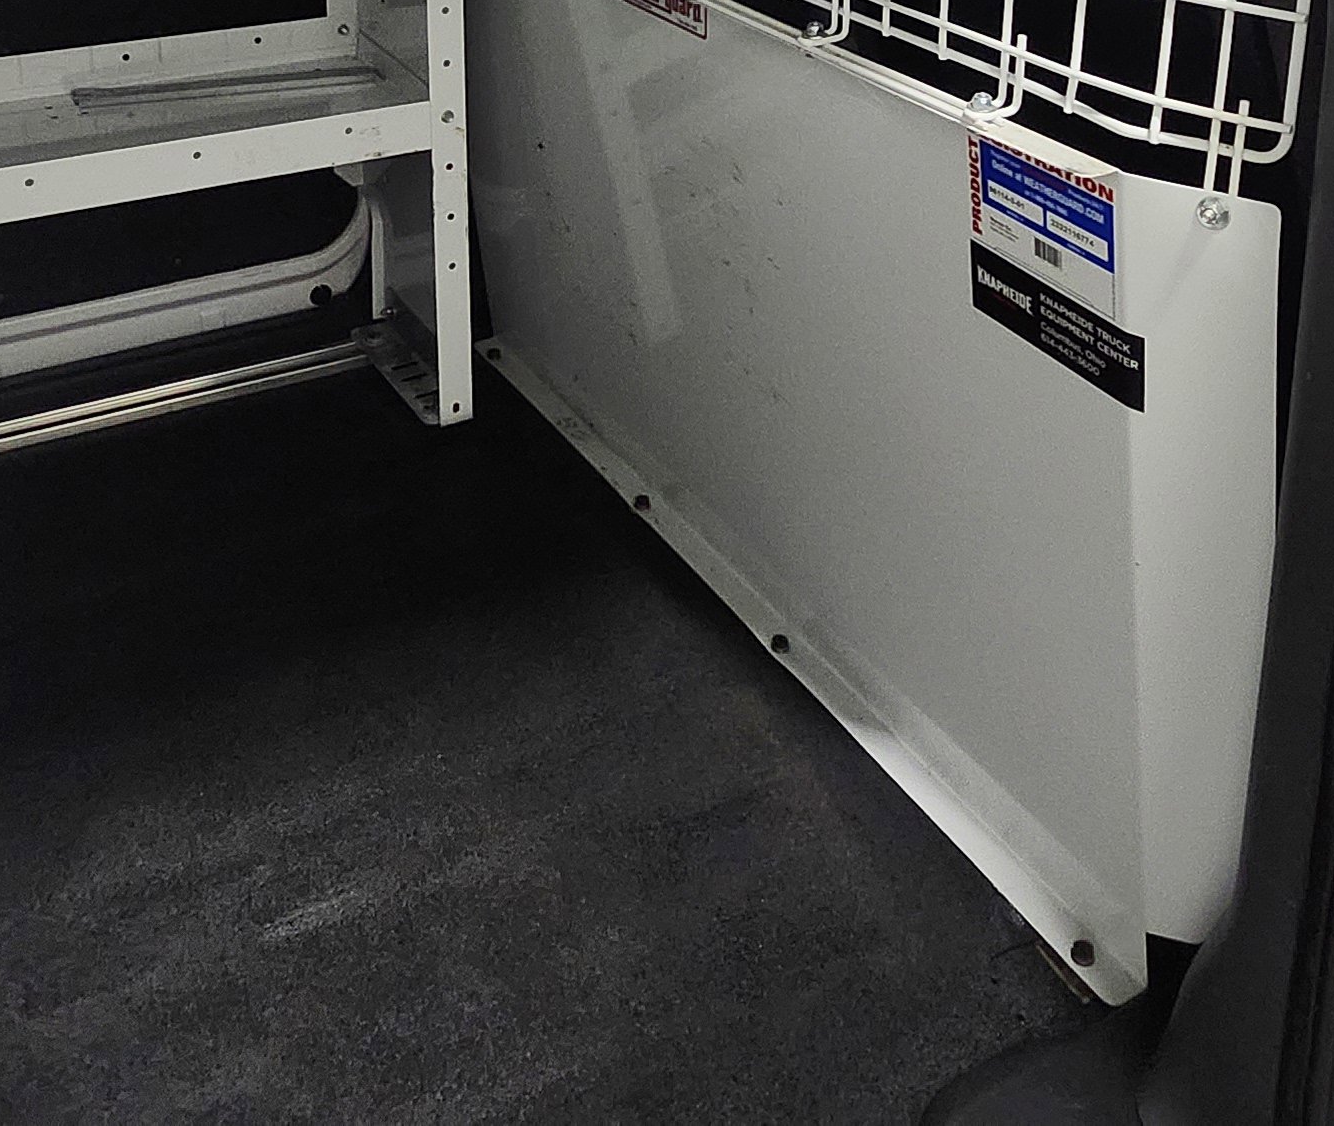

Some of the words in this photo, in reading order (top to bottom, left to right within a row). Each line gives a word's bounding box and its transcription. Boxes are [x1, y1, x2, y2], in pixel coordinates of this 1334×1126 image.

[968, 135, 983, 235] PRODUCT
[977, 134, 1114, 203] STRATION
[976, 264, 1034, 316] KNAPHEIDE
[1039, 292, 1095, 334] KNAPHEIDE
[1096, 326, 1132, 355] TRUCK
[1040, 305, 1095, 346] EQUIPMENT
[1096, 340, 1140, 371] CENTER
